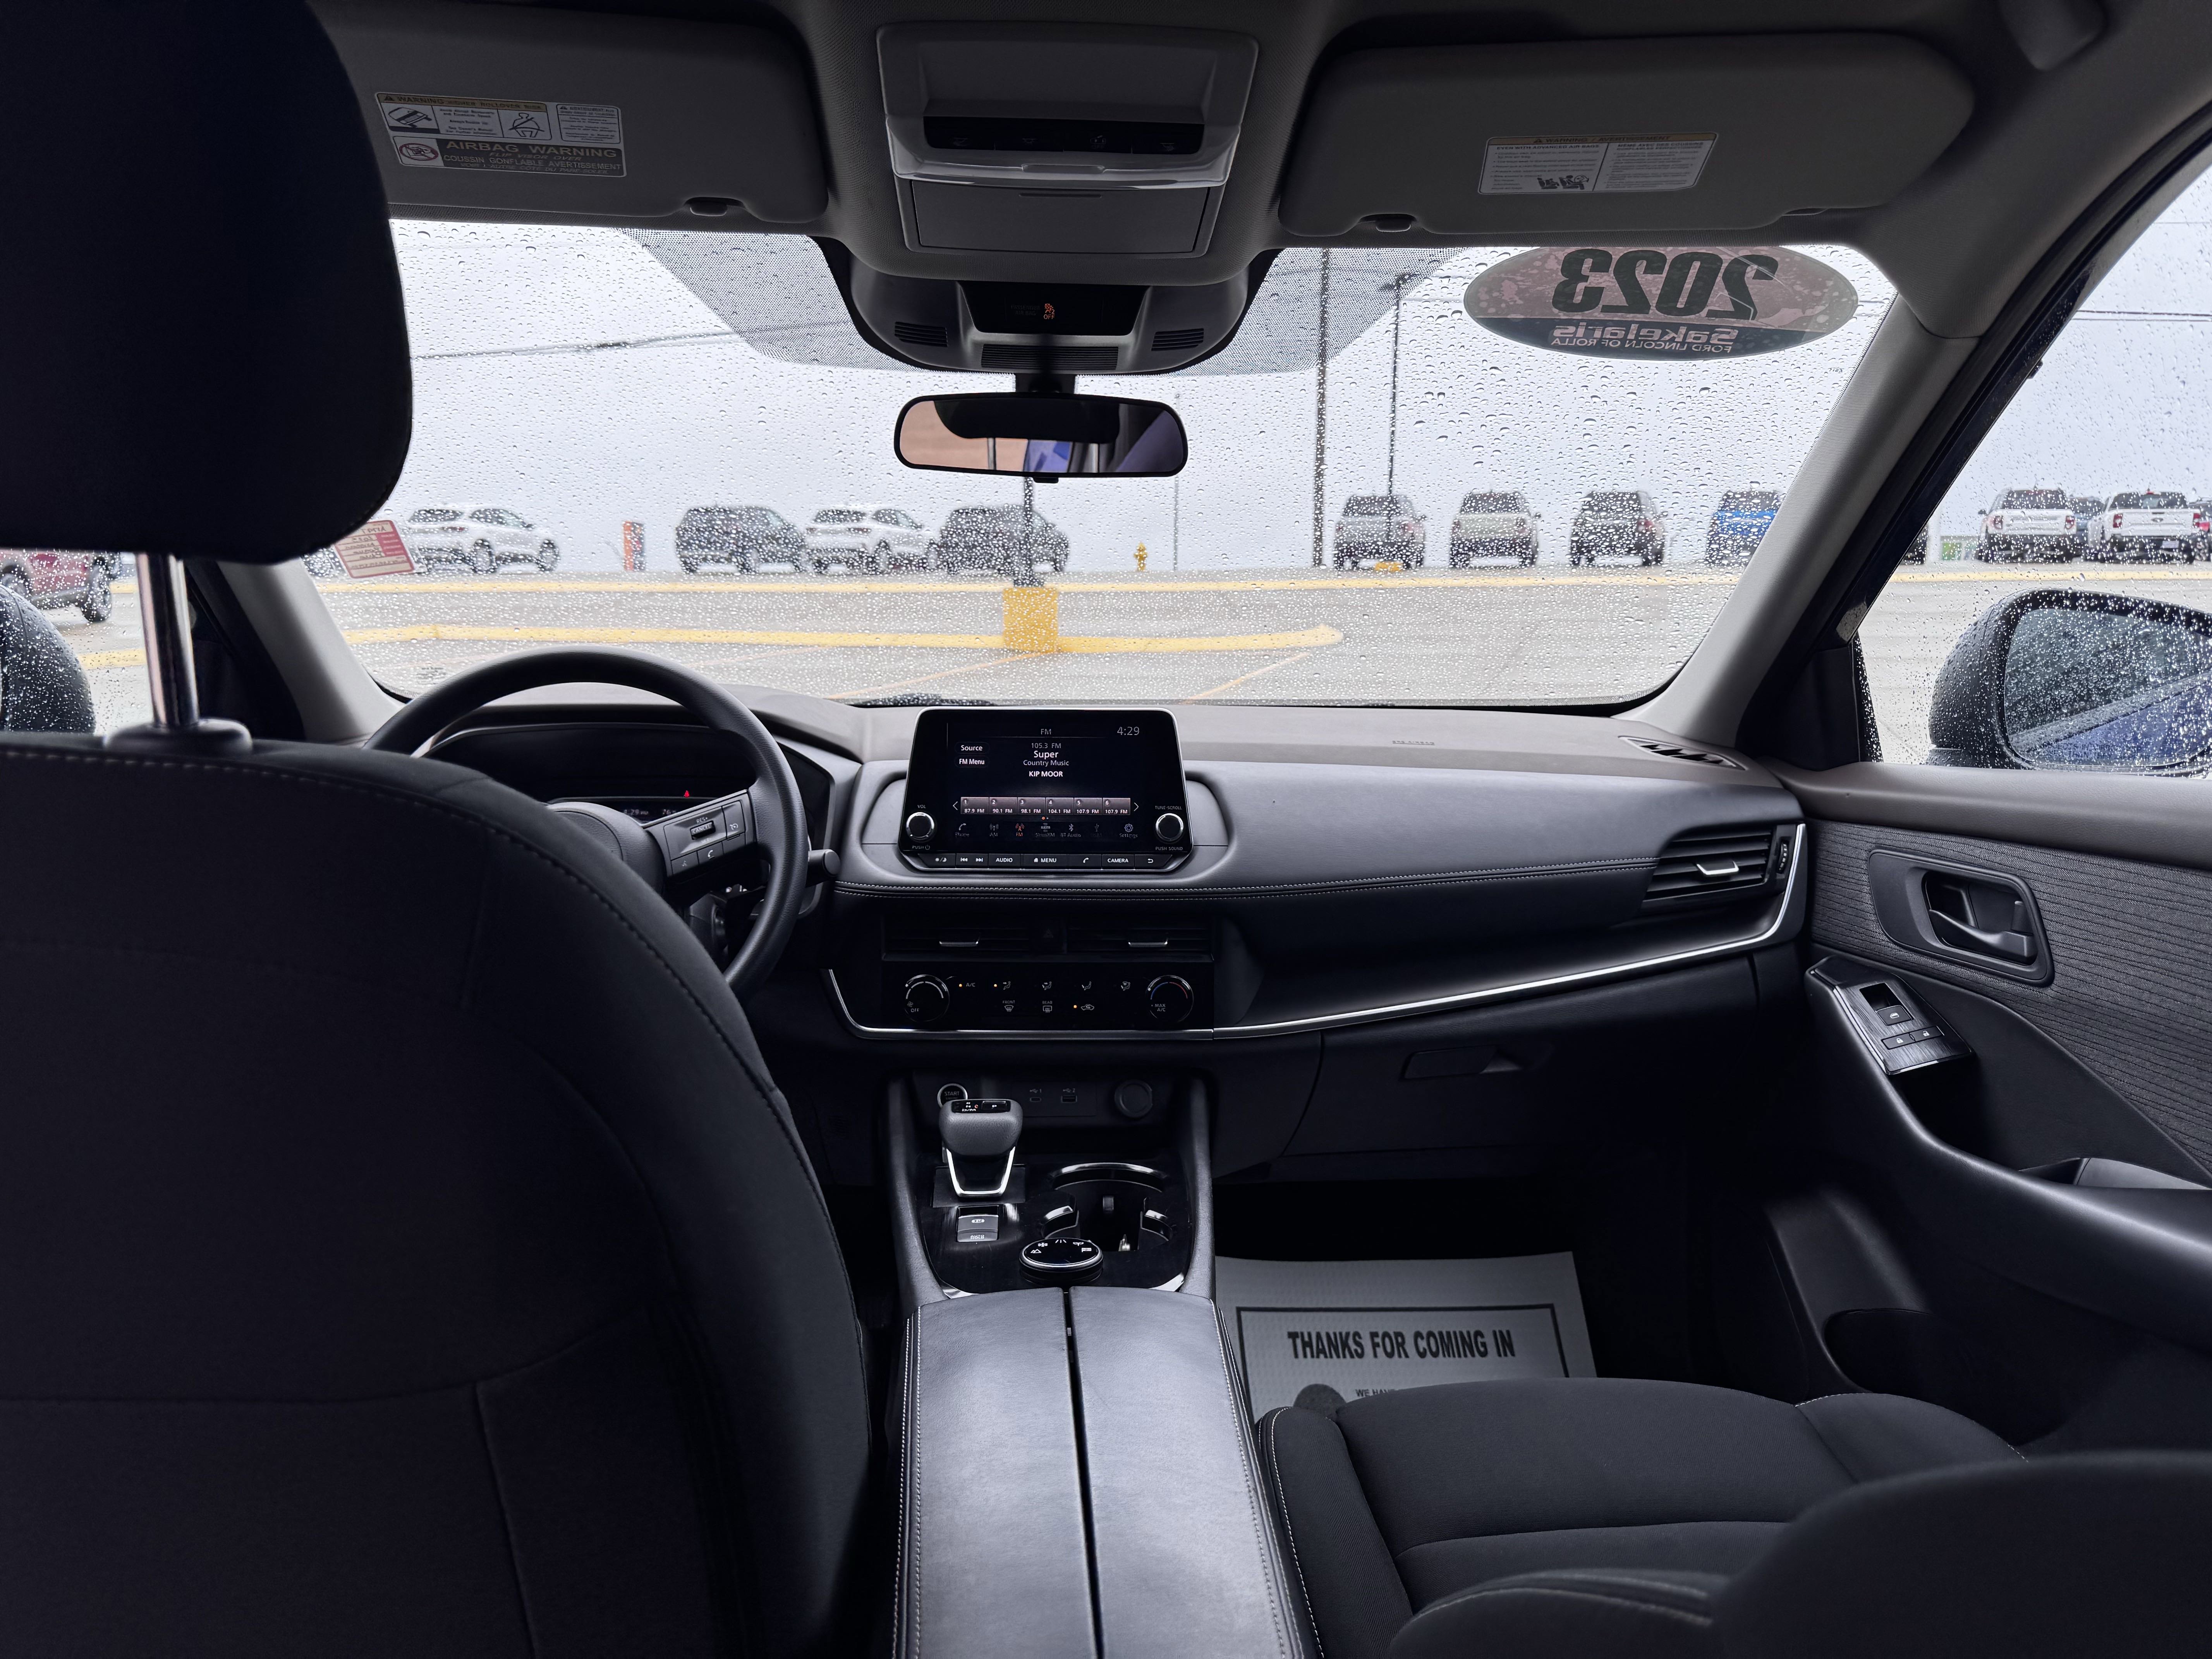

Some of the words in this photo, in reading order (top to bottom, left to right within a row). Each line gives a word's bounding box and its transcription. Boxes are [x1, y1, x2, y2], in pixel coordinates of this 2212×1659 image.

[446, 141, 519, 152] AIRBAG
[529, 146, 617, 157] WARNING
[489, 158, 544, 166] GONFLABLE
[548, 161, 622, 170] AVERTISSEMENT
[1117, 726, 1140, 735] 4:29
[1034, 750, 1058, 759] Super
[693, 824, 711, 834] CANCEL
[1287, 1330, 1365, 1358] THANKS
[1369, 1330, 1409, 1358] FOR
[1413, 1329, 1488, 1358] COMING
[1492, 1329, 1516, 1358] IN
[1355, 1389, 1370, 1397] WE
